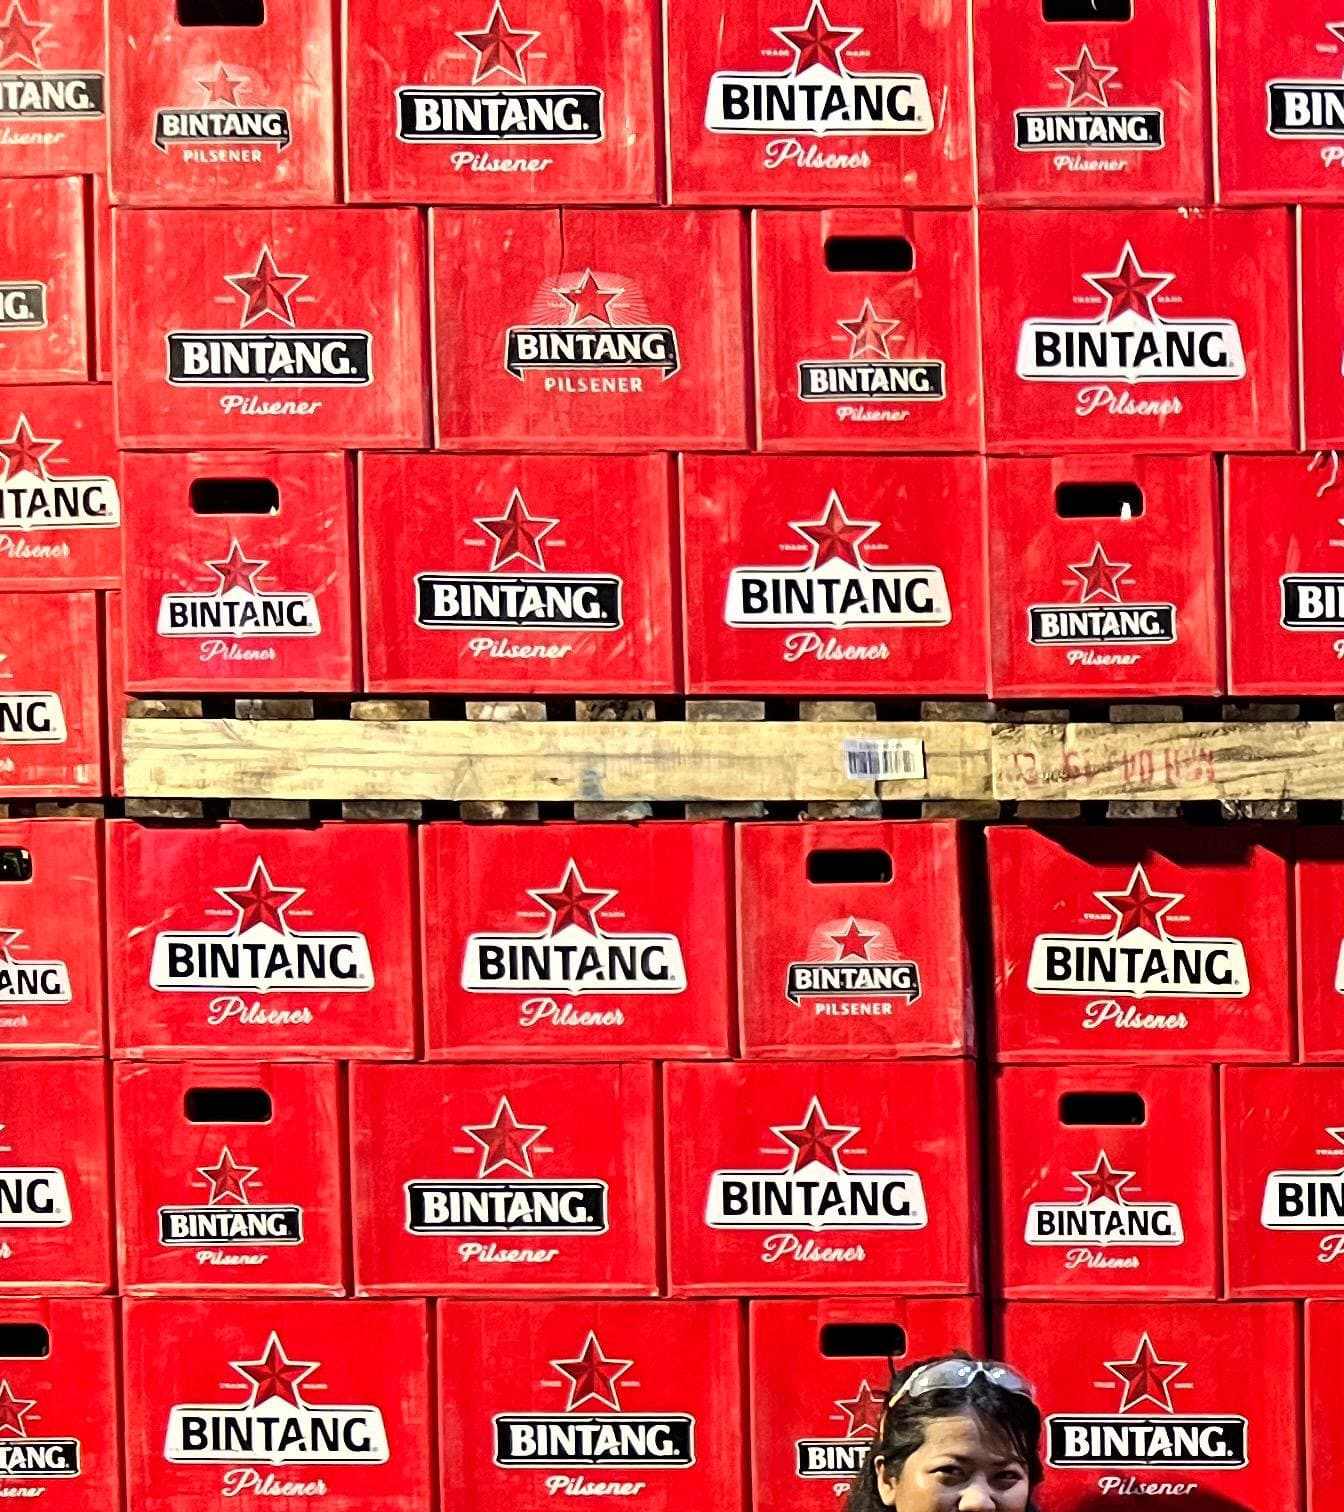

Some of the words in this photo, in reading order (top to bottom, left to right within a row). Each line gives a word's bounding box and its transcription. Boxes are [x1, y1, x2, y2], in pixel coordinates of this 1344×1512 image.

[724, 84, 916, 121] BINTANG
[183, 149, 262, 162] PILSENER
[1034, 331, 1228, 368] BINTANG
[544, 376, 642, 393] PILSENER
[217, 394, 321, 416] Pilsener
[742, 578, 933, 615] BINTANG
[782, 631, 888, 661] Pilsener
[167, 943, 358, 980] BINTANG
[478, 945, 669, 982] BINTANG
[1046, 948, 1233, 984] BINTANG
[207, 996, 313, 1026] Pilsener
[814, 1002, 892, 1015] PILSENER
[1085, 1000, 1189, 1030] Pilsener
[723, 1181, 910, 1217] BINTANG
[458, 1242, 558, 1264] Pilsener
[183, 1416, 370, 1452] BINTANG
[222, 1468, 326, 1498] Pilsener
[545, 1475, 645, 1497] Pilsener
